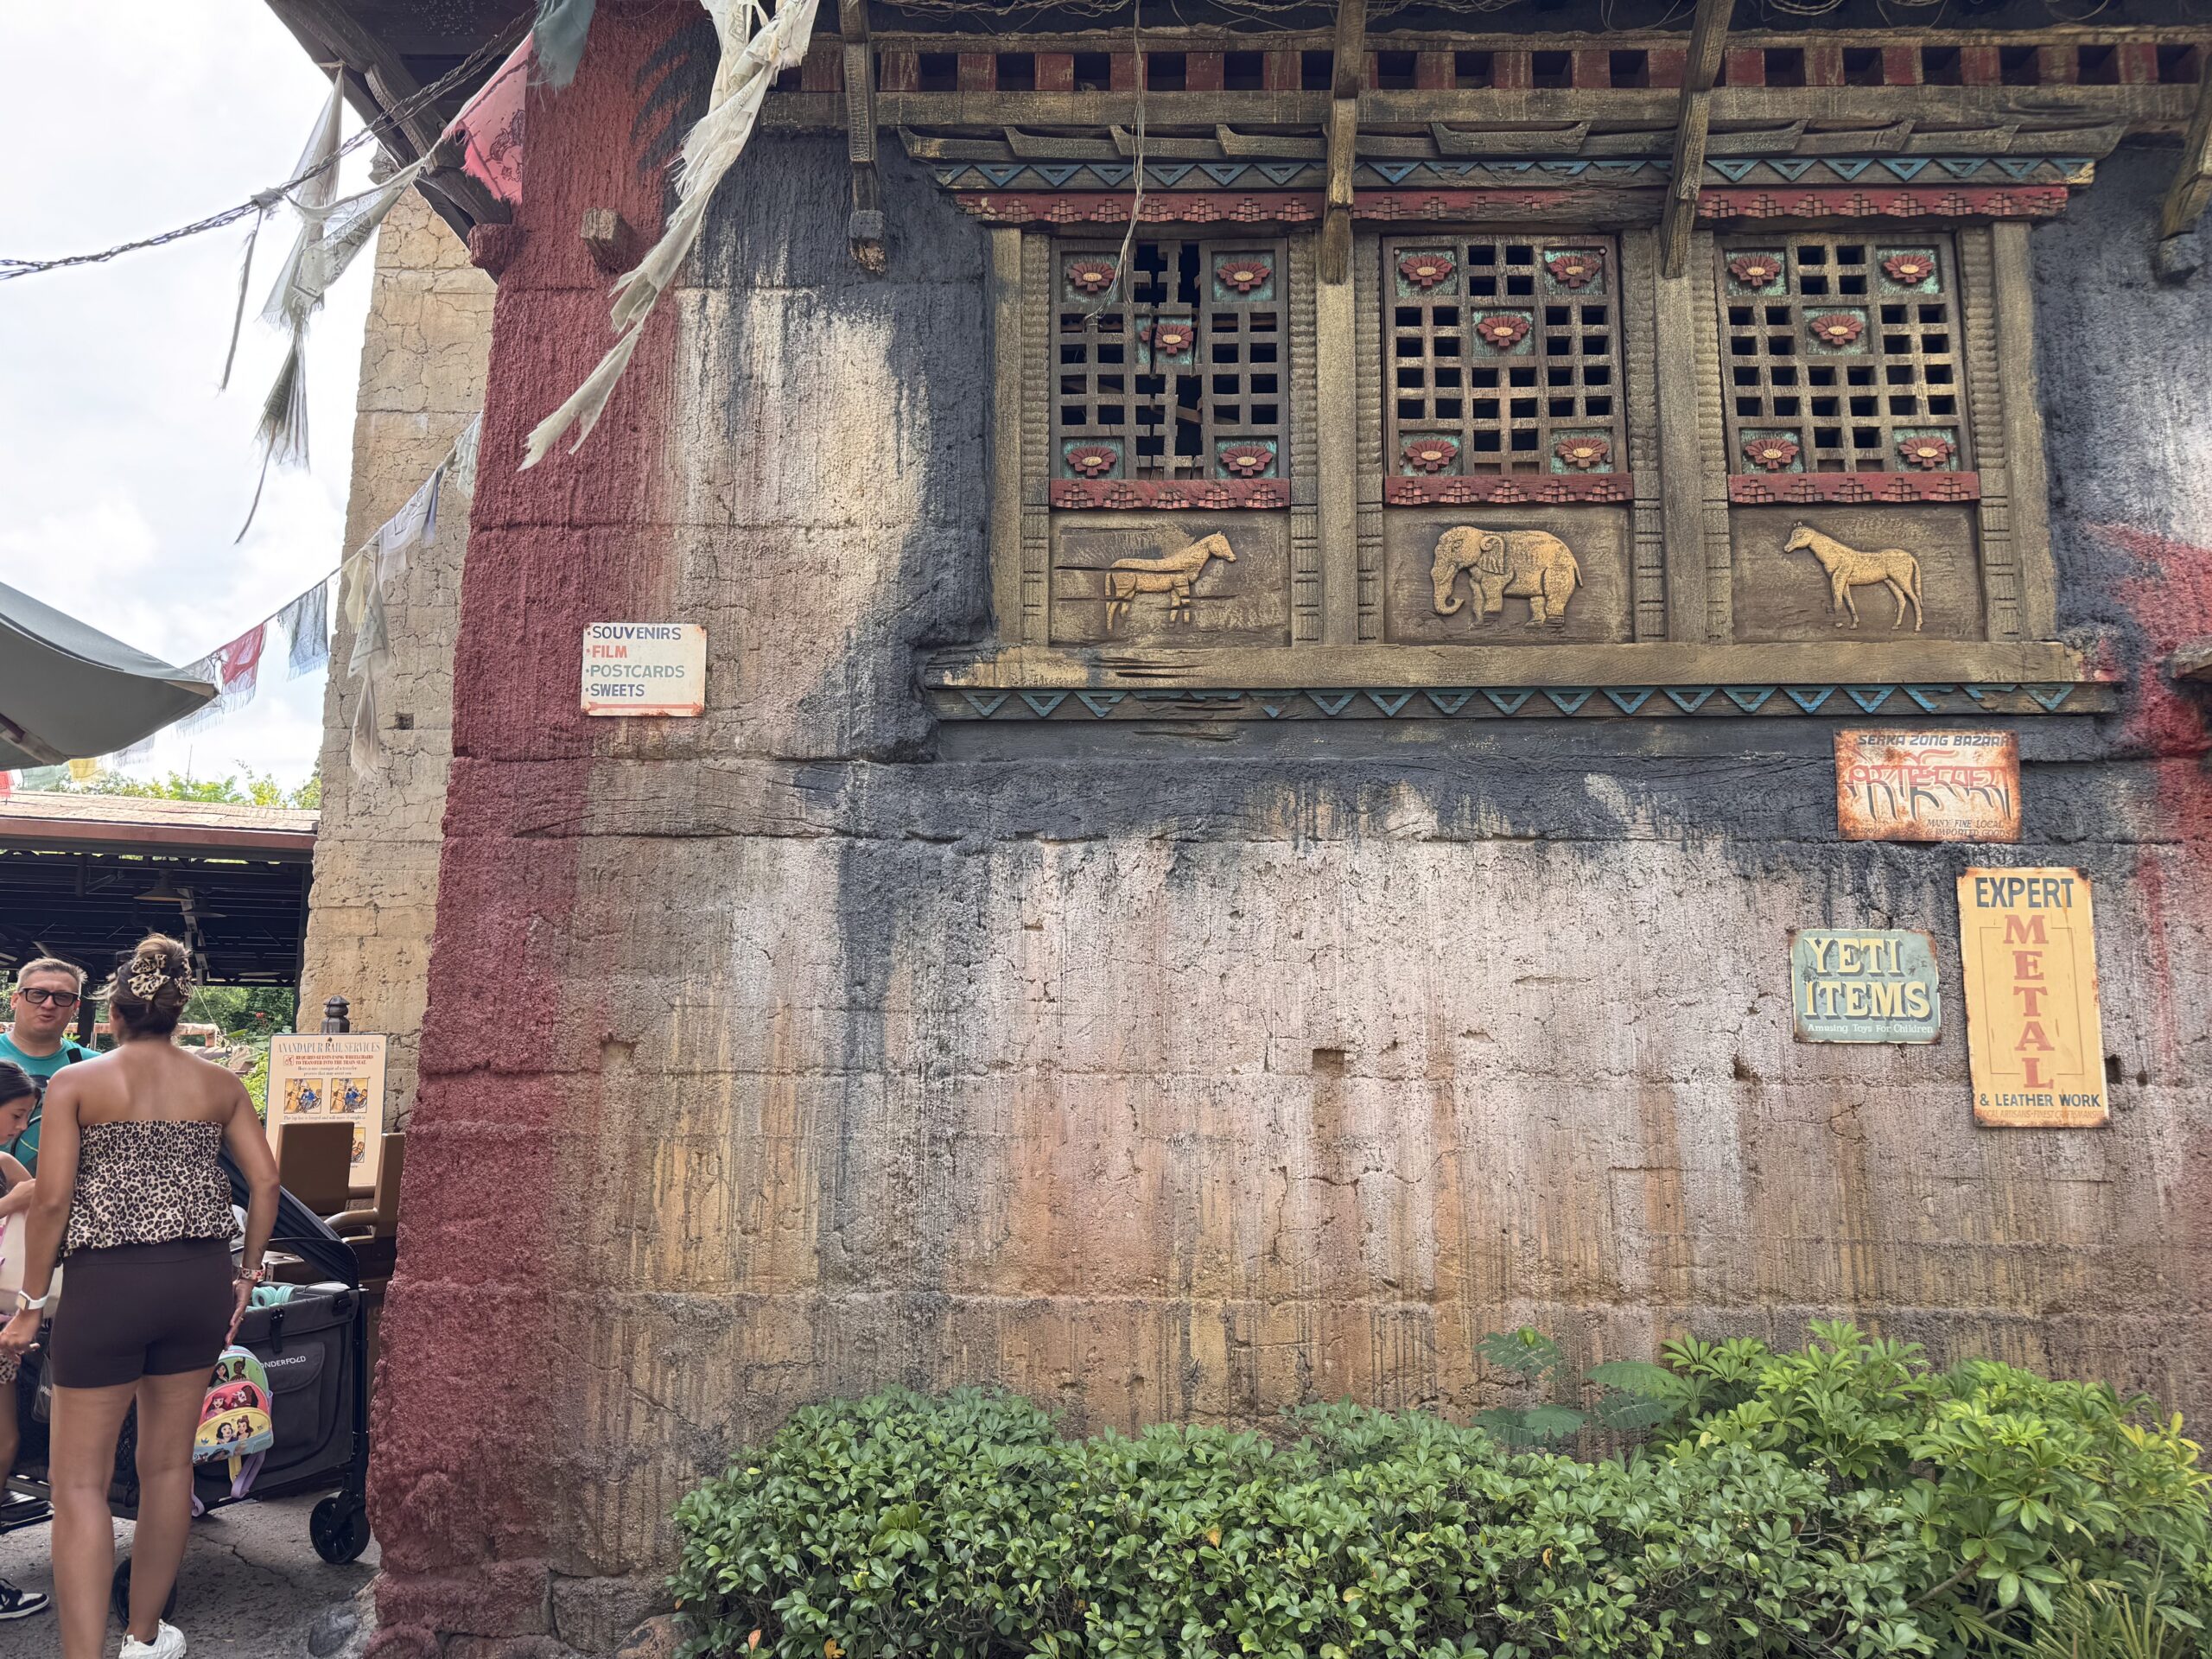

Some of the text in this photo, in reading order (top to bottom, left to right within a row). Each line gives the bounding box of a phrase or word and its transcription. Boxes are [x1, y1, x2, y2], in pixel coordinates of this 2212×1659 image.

[592, 626, 682, 640] SOUVENIRS
[592, 645, 627, 658] FILM
[590, 664, 685, 678] POSTCARDS
[590, 683, 645, 697] SWEETS
[1859, 734, 2010, 747] SERKA ZONG BAZAAR
[1927, 819, 2004, 829] MANY FINE LOCAL
[1936, 829, 1979, 837] IMPORTED
[1981, 830, 2011, 838] GOODS
[1974, 877, 2075, 908] EXPERT
[1803, 938, 1903, 976] YETI
[1803, 981, 1931, 1020] ITEMS
[2003, 914, 2055, 1090] METAL
[1807, 1024, 1934, 1033] Amusing Toys For Children
[325, 1042, 343, 1052] RAIL
[344, 1042, 380, 1052] SERVICES
[1980, 1093, 2101, 1107] & LEATHER WORK
[1977, 1109, 1999, 1118] OCAL
[260, 1355, 307, 1369] ONDERFOLD
